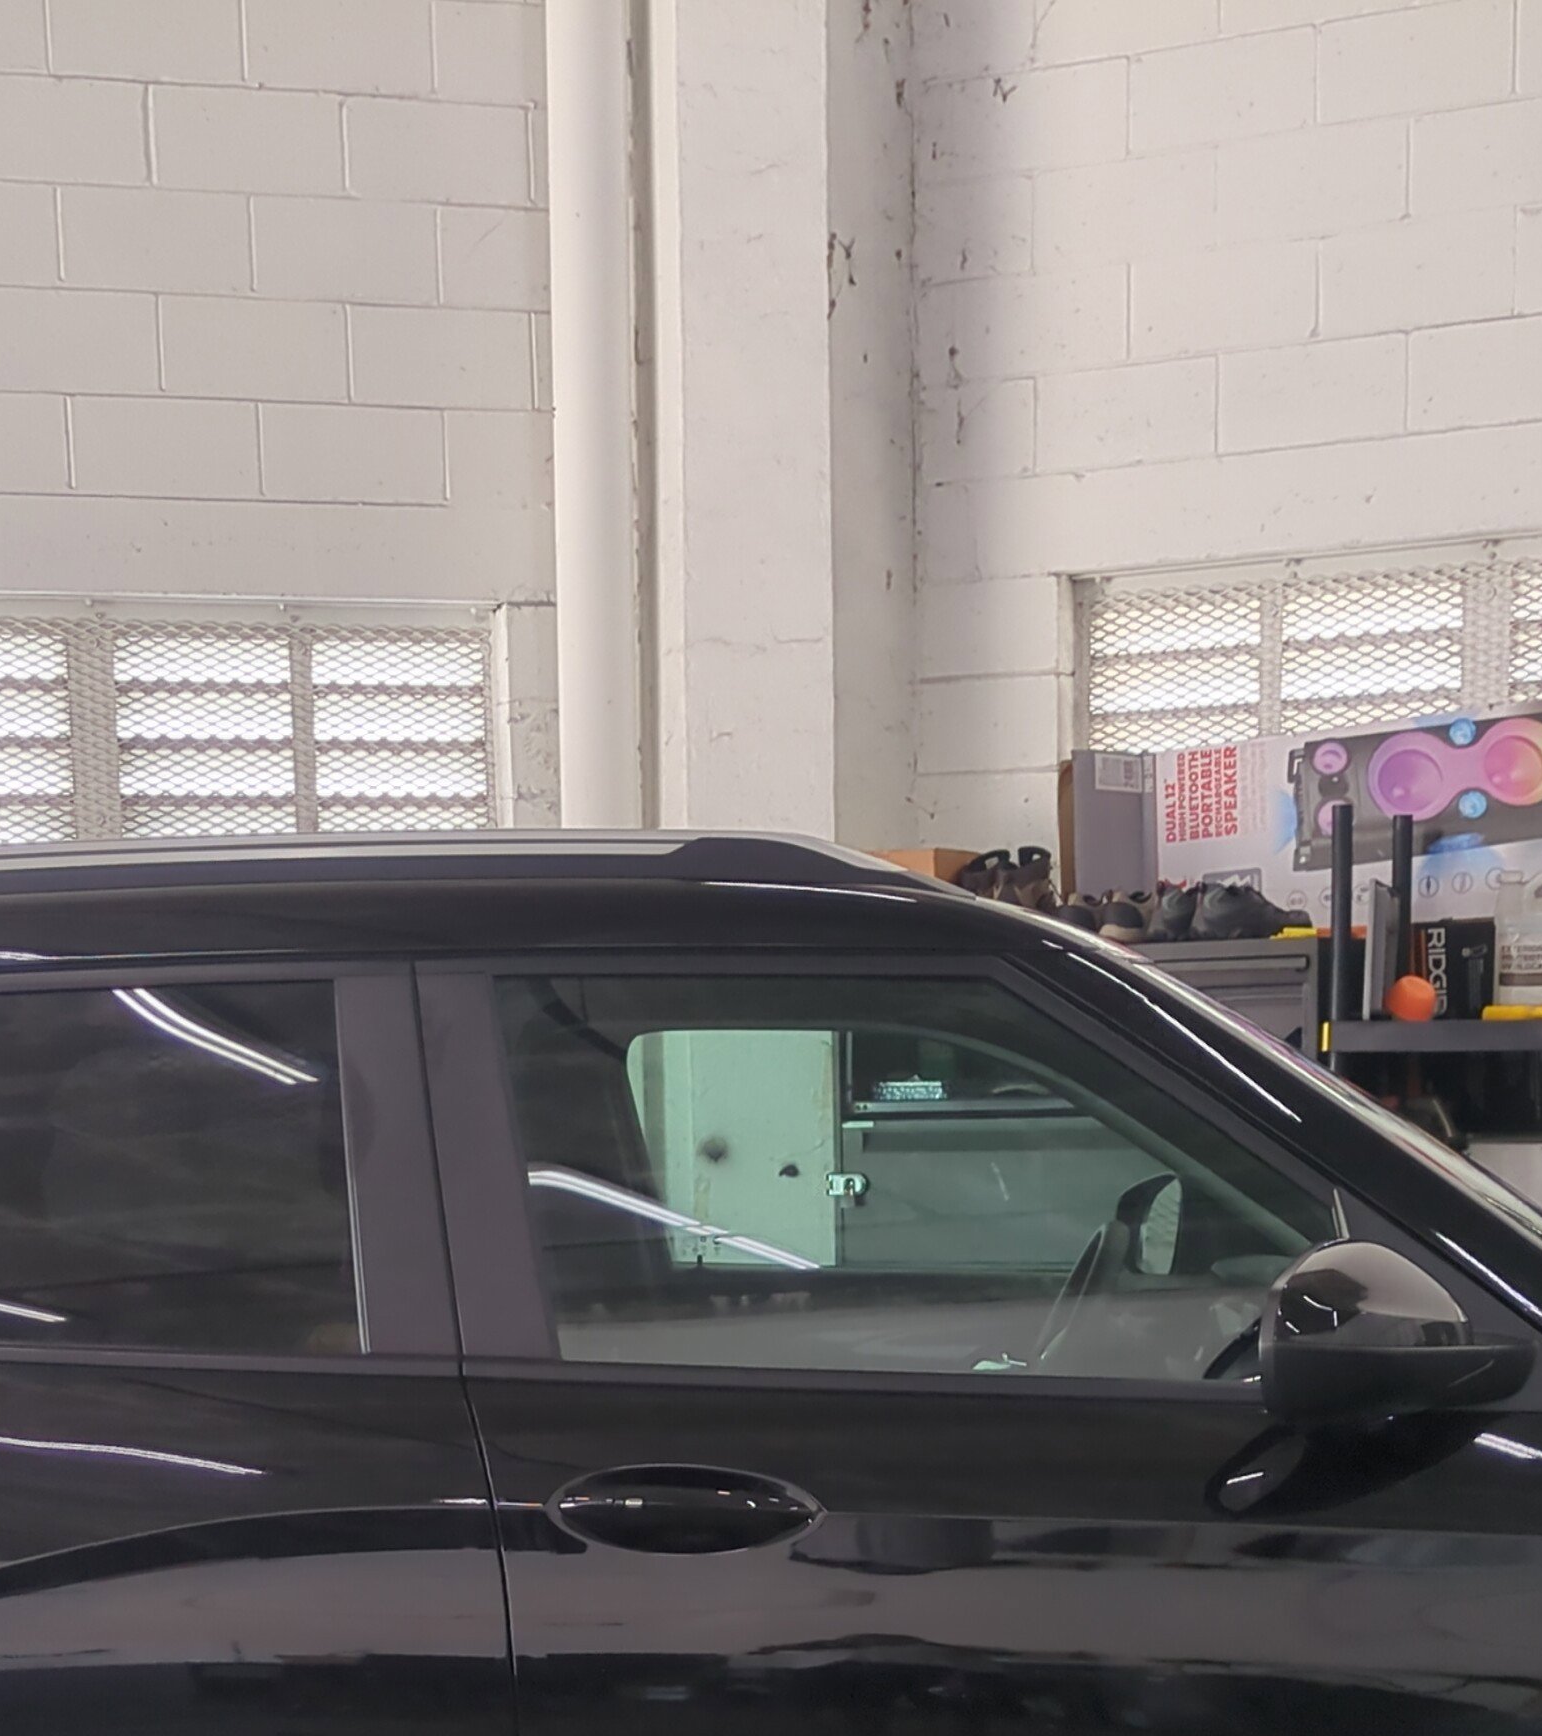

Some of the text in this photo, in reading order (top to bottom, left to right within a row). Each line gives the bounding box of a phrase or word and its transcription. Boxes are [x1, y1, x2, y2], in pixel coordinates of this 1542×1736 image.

[1165, 801, 1177, 843] DUAL
[1176, 752, 1187, 810] POWERED
[1188, 751, 1200, 840] BLUETOOTH
[1200, 748, 1213, 839] PORTABLE
[1214, 748, 1223, 838] RECHARGEABLE
[1223, 745, 1238, 836] SPEAKER
[1428, 927, 1448, 1016] RIDGID
